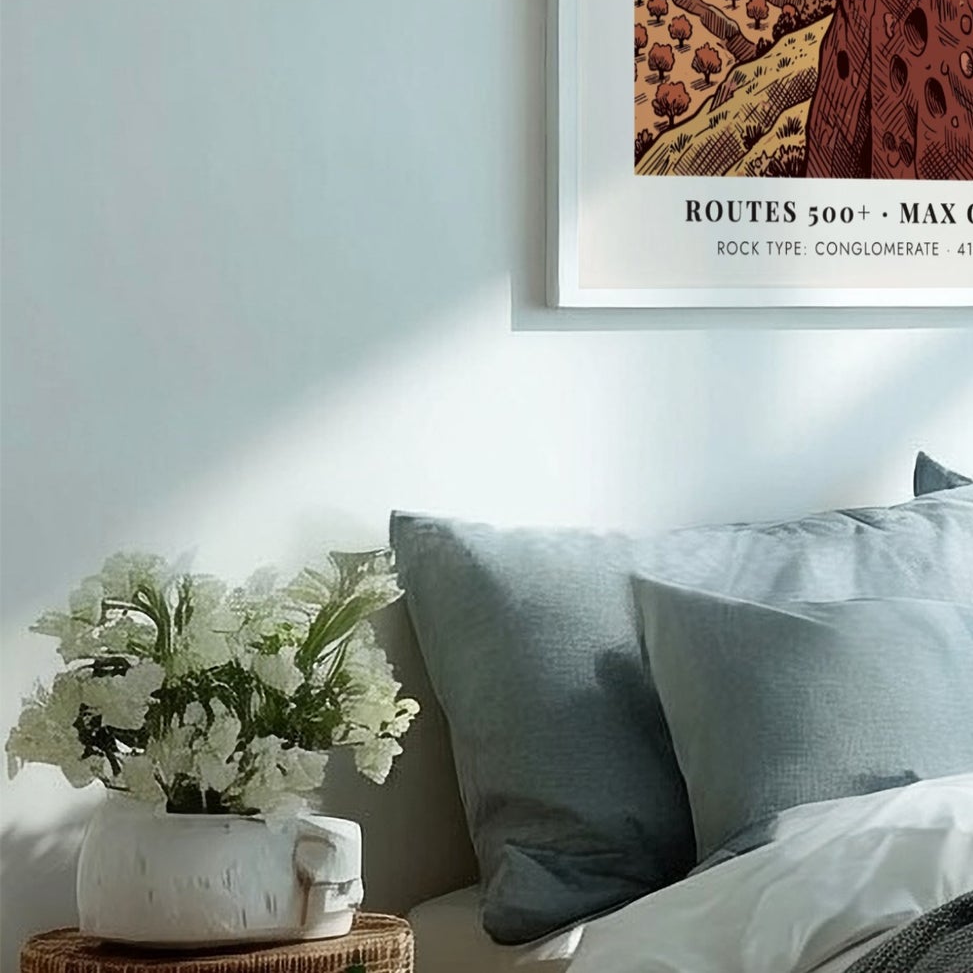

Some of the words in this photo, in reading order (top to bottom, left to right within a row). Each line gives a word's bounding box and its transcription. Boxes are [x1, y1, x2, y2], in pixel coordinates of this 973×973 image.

[685, 199, 797, 224] ROUTES
[808, 204, 871, 227] 500+
[900, 202, 957, 225] MAX
[717, 240, 760, 257] ROCK
[766, 240, 807, 257] TYPE:
[815, 241, 939, 257] CONGLOMERATE
